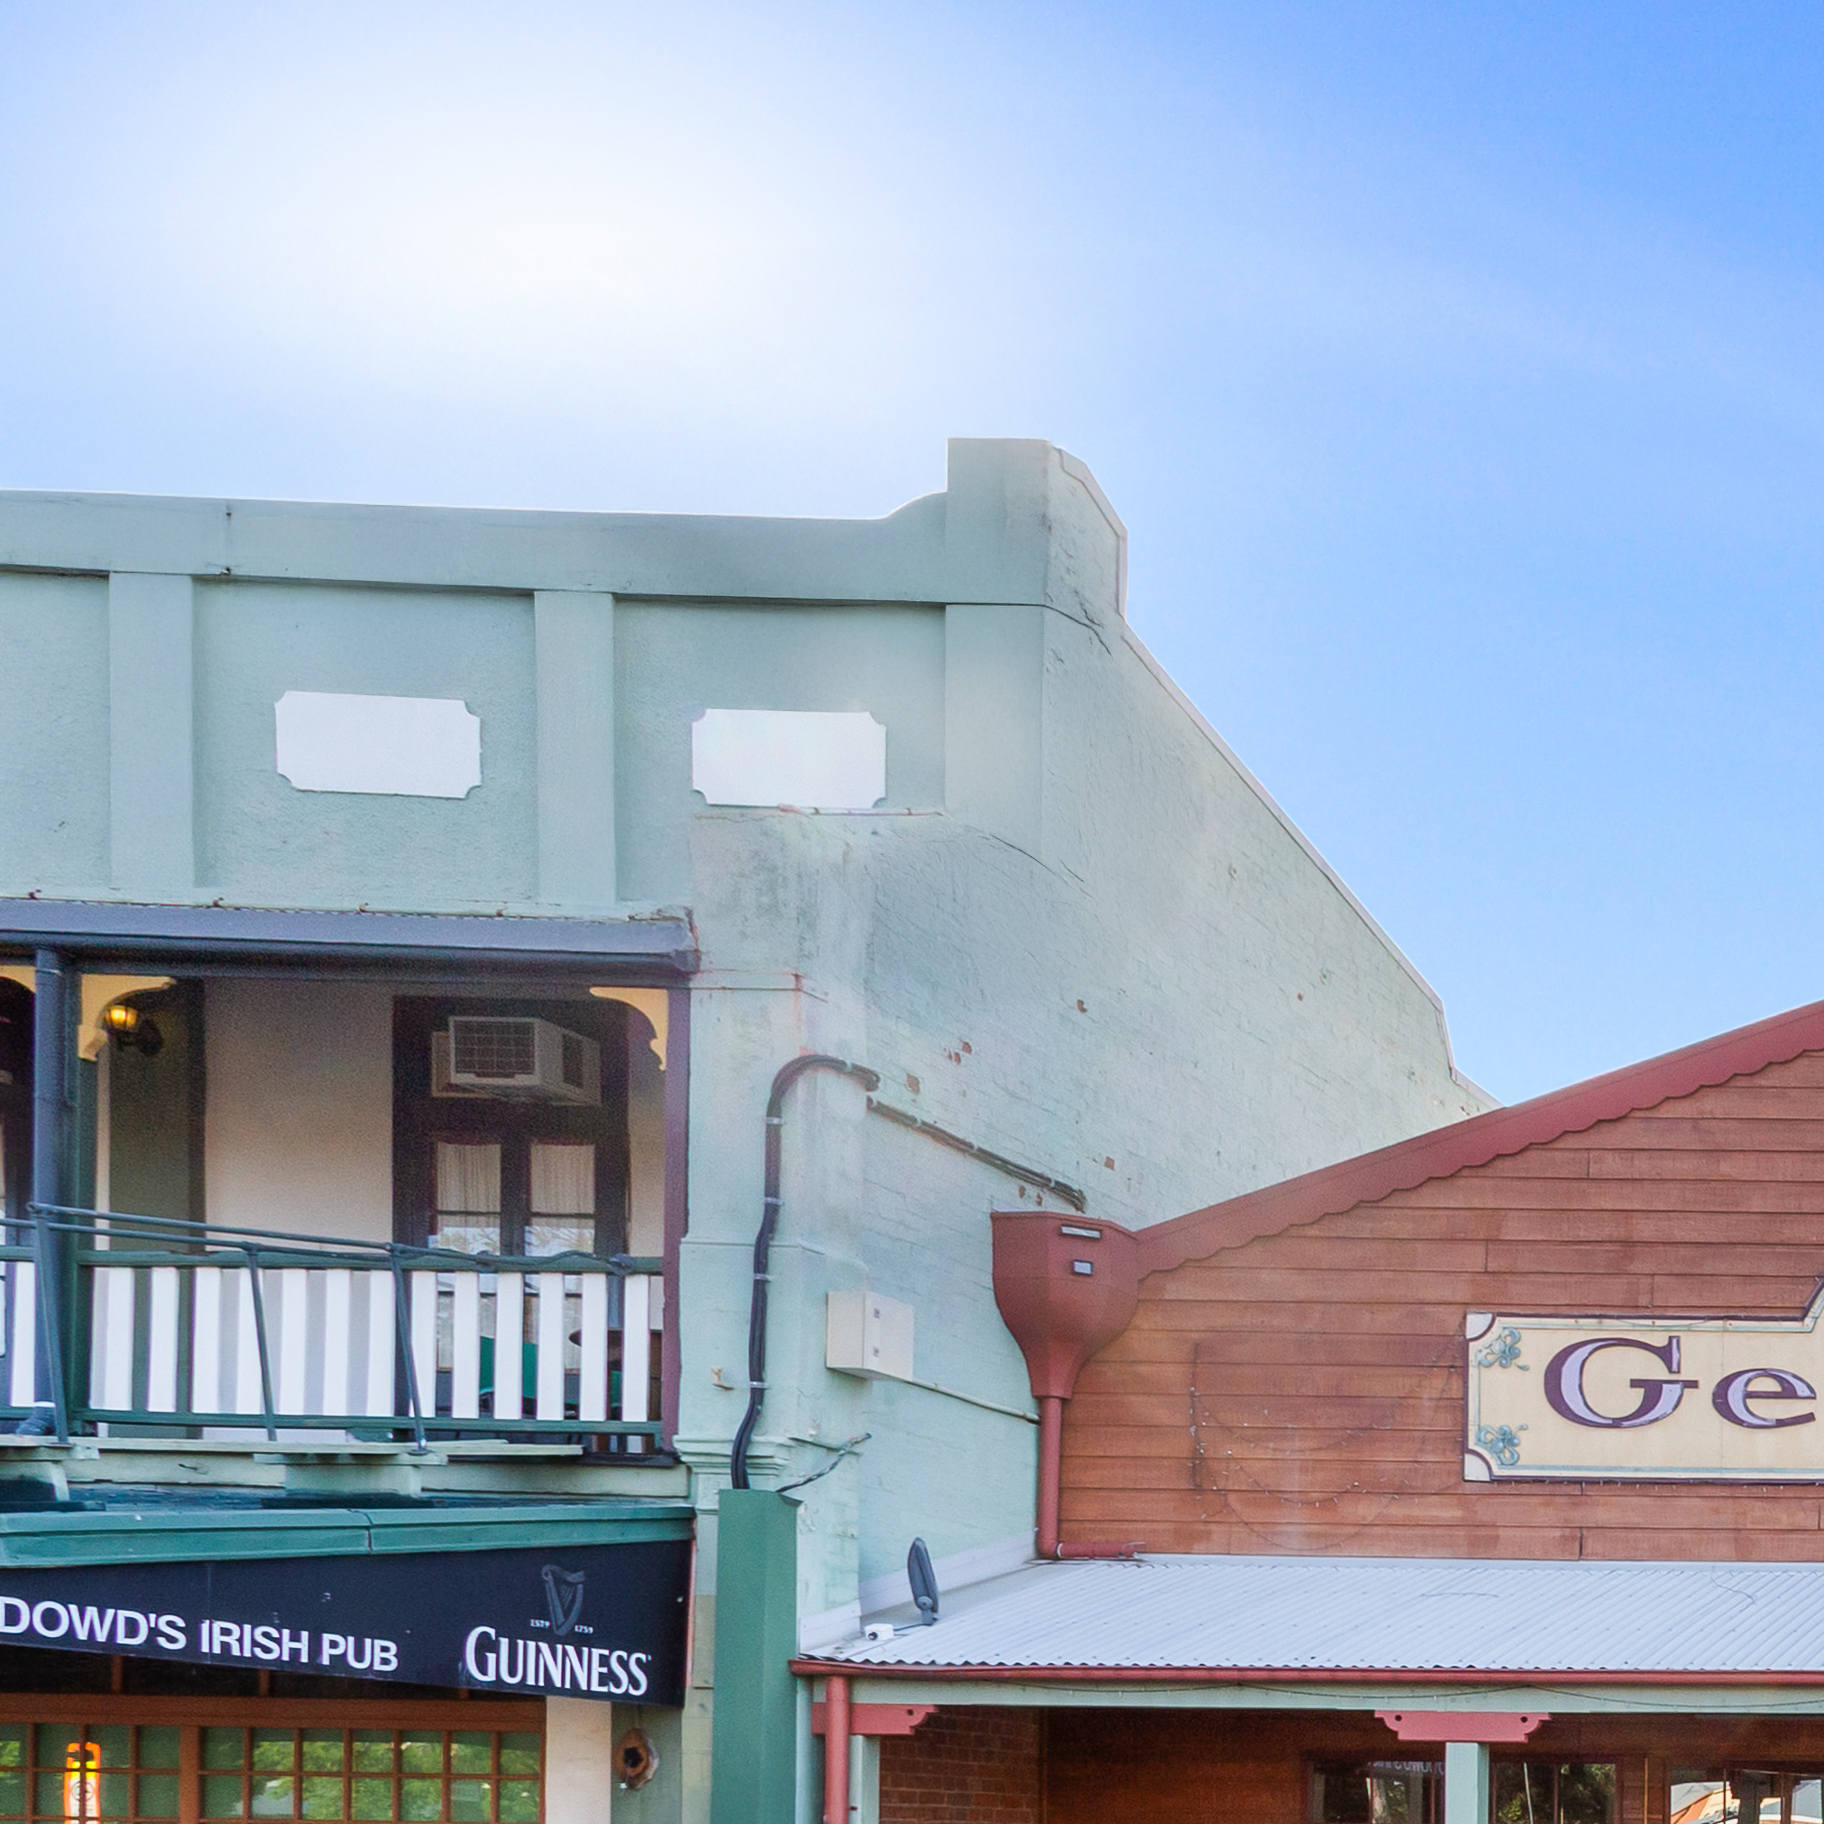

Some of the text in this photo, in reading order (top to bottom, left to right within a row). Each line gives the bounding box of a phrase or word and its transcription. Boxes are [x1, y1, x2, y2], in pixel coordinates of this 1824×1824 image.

[199, 1619, 310, 1664] IRISH
[320, 1632, 399, 1672] PUB
[465, 1626, 648, 1696] GUINNESS
